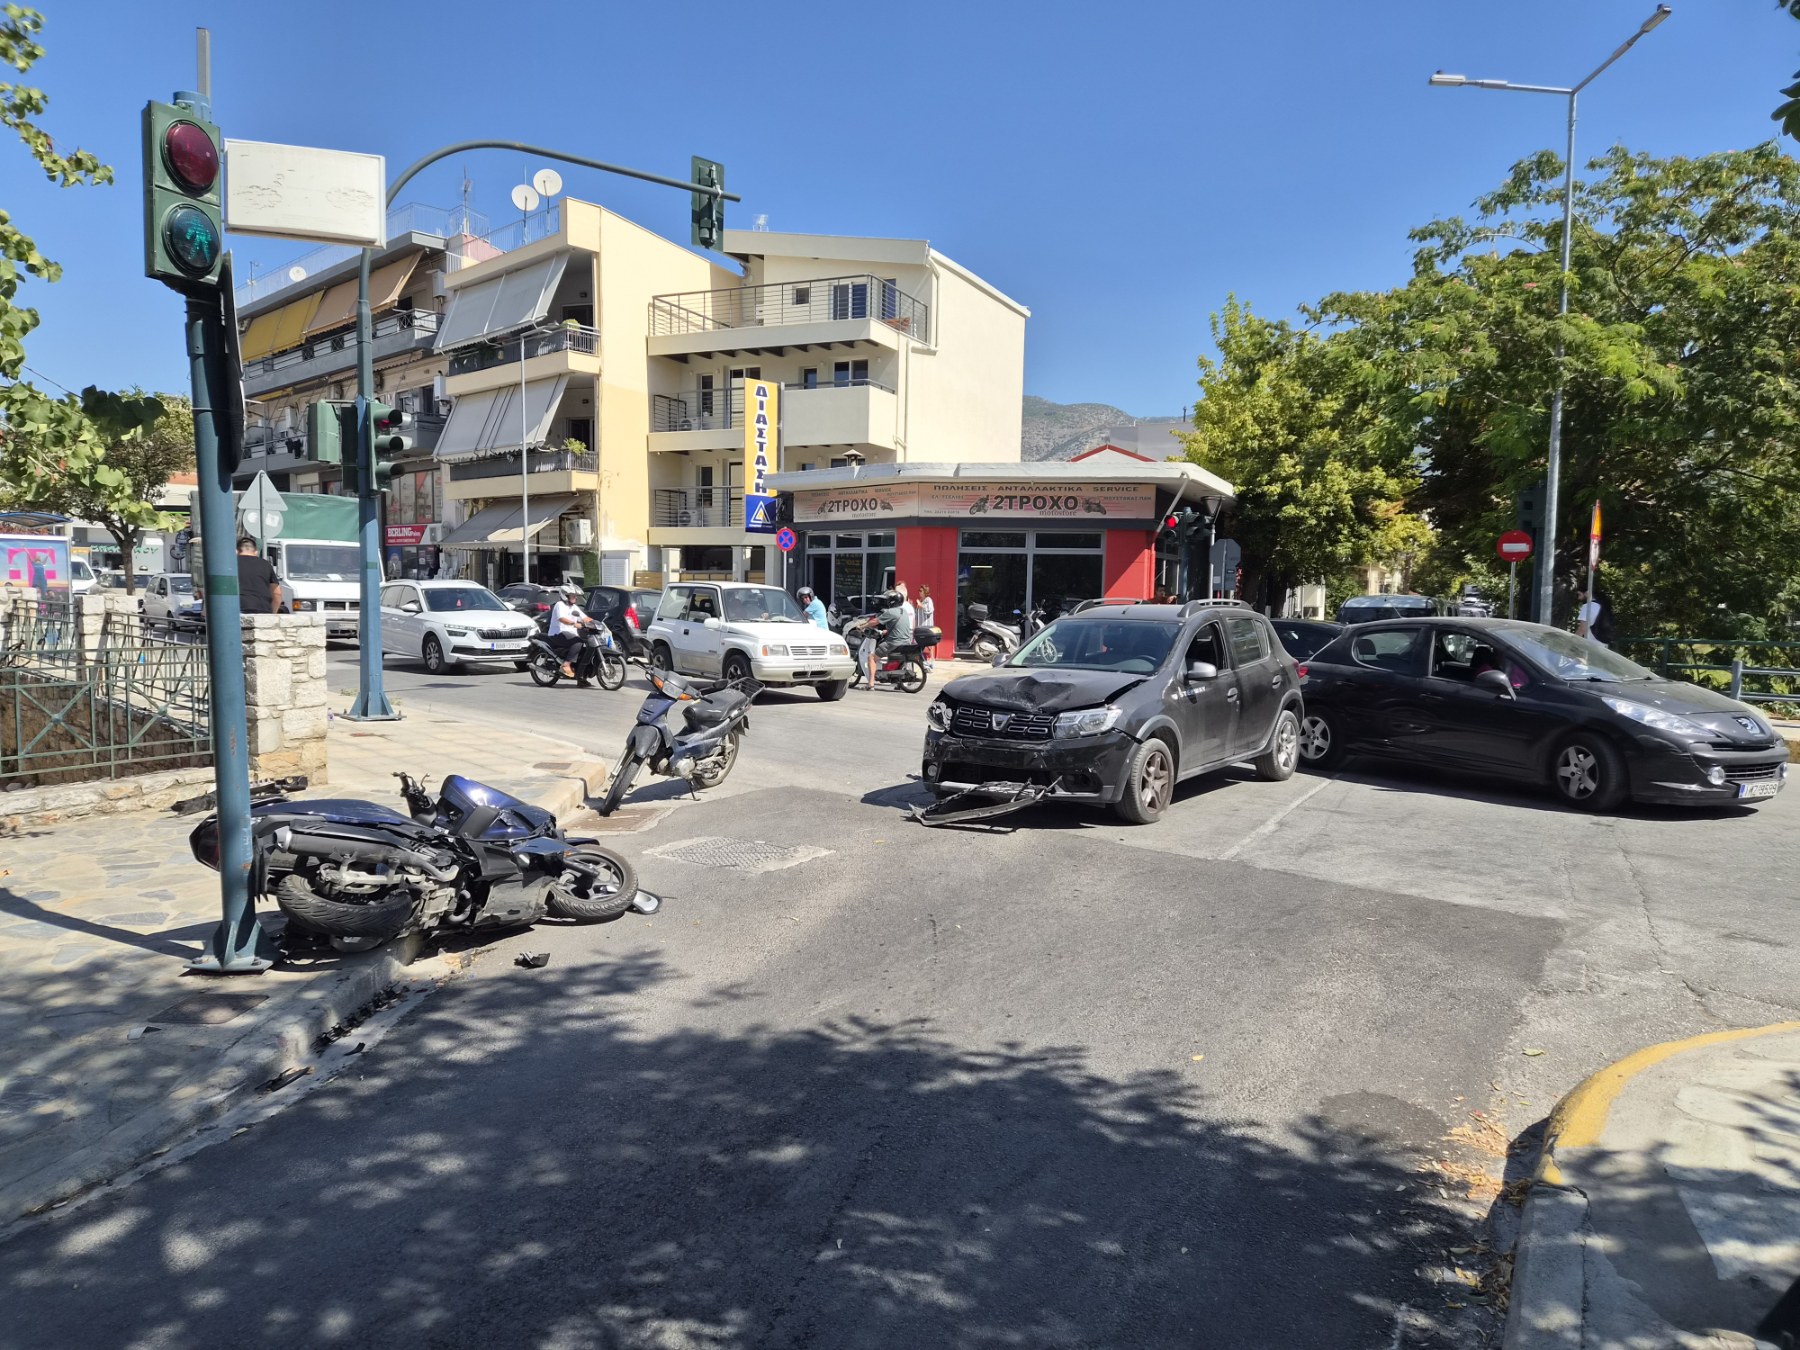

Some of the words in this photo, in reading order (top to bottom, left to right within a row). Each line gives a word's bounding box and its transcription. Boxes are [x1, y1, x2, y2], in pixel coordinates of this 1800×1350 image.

[827, 497, 878, 513] 2ΤΡΟΧΟ
[992, 495, 1079, 511] 2ΤΡΟΧΟ
[387, 527, 412, 537] BERLING
